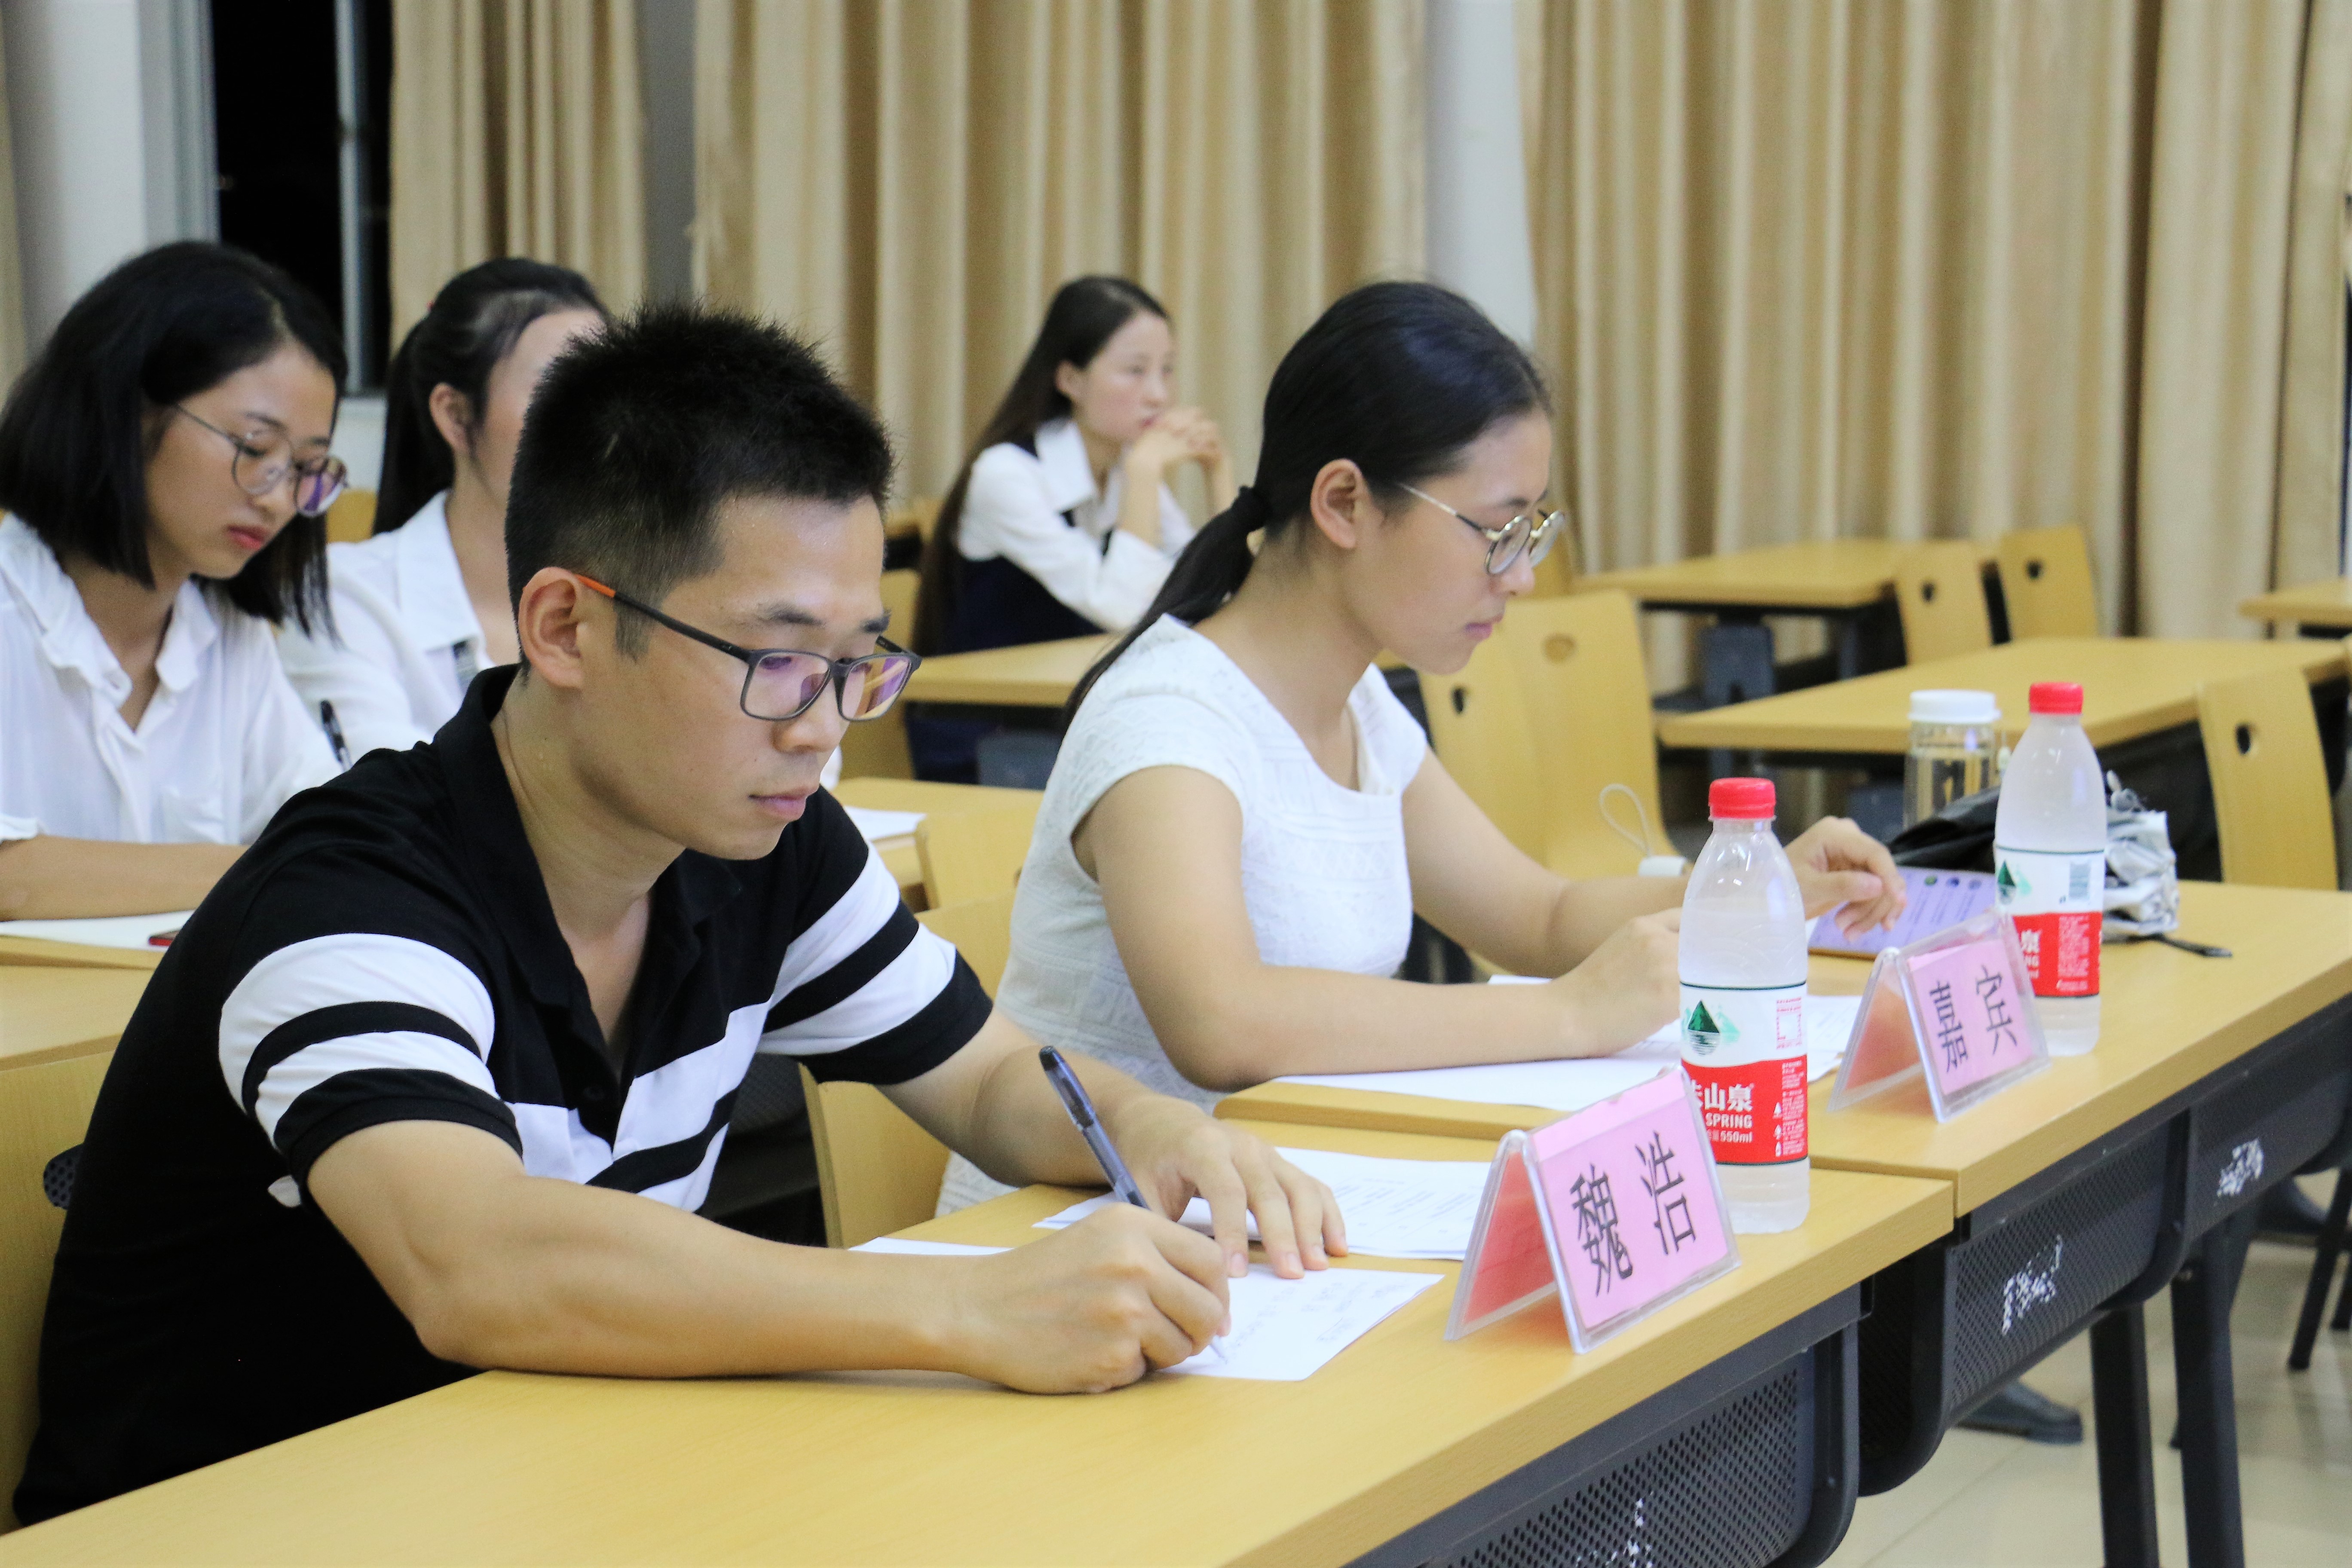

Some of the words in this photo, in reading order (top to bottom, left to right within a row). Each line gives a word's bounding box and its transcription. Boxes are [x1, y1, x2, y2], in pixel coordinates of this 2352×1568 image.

[1929, 964, 2018, 1073] 嘉宾
[1705, 1112, 1753, 1129] SPRING
[1570, 1130, 1696, 1298] 魏浩
